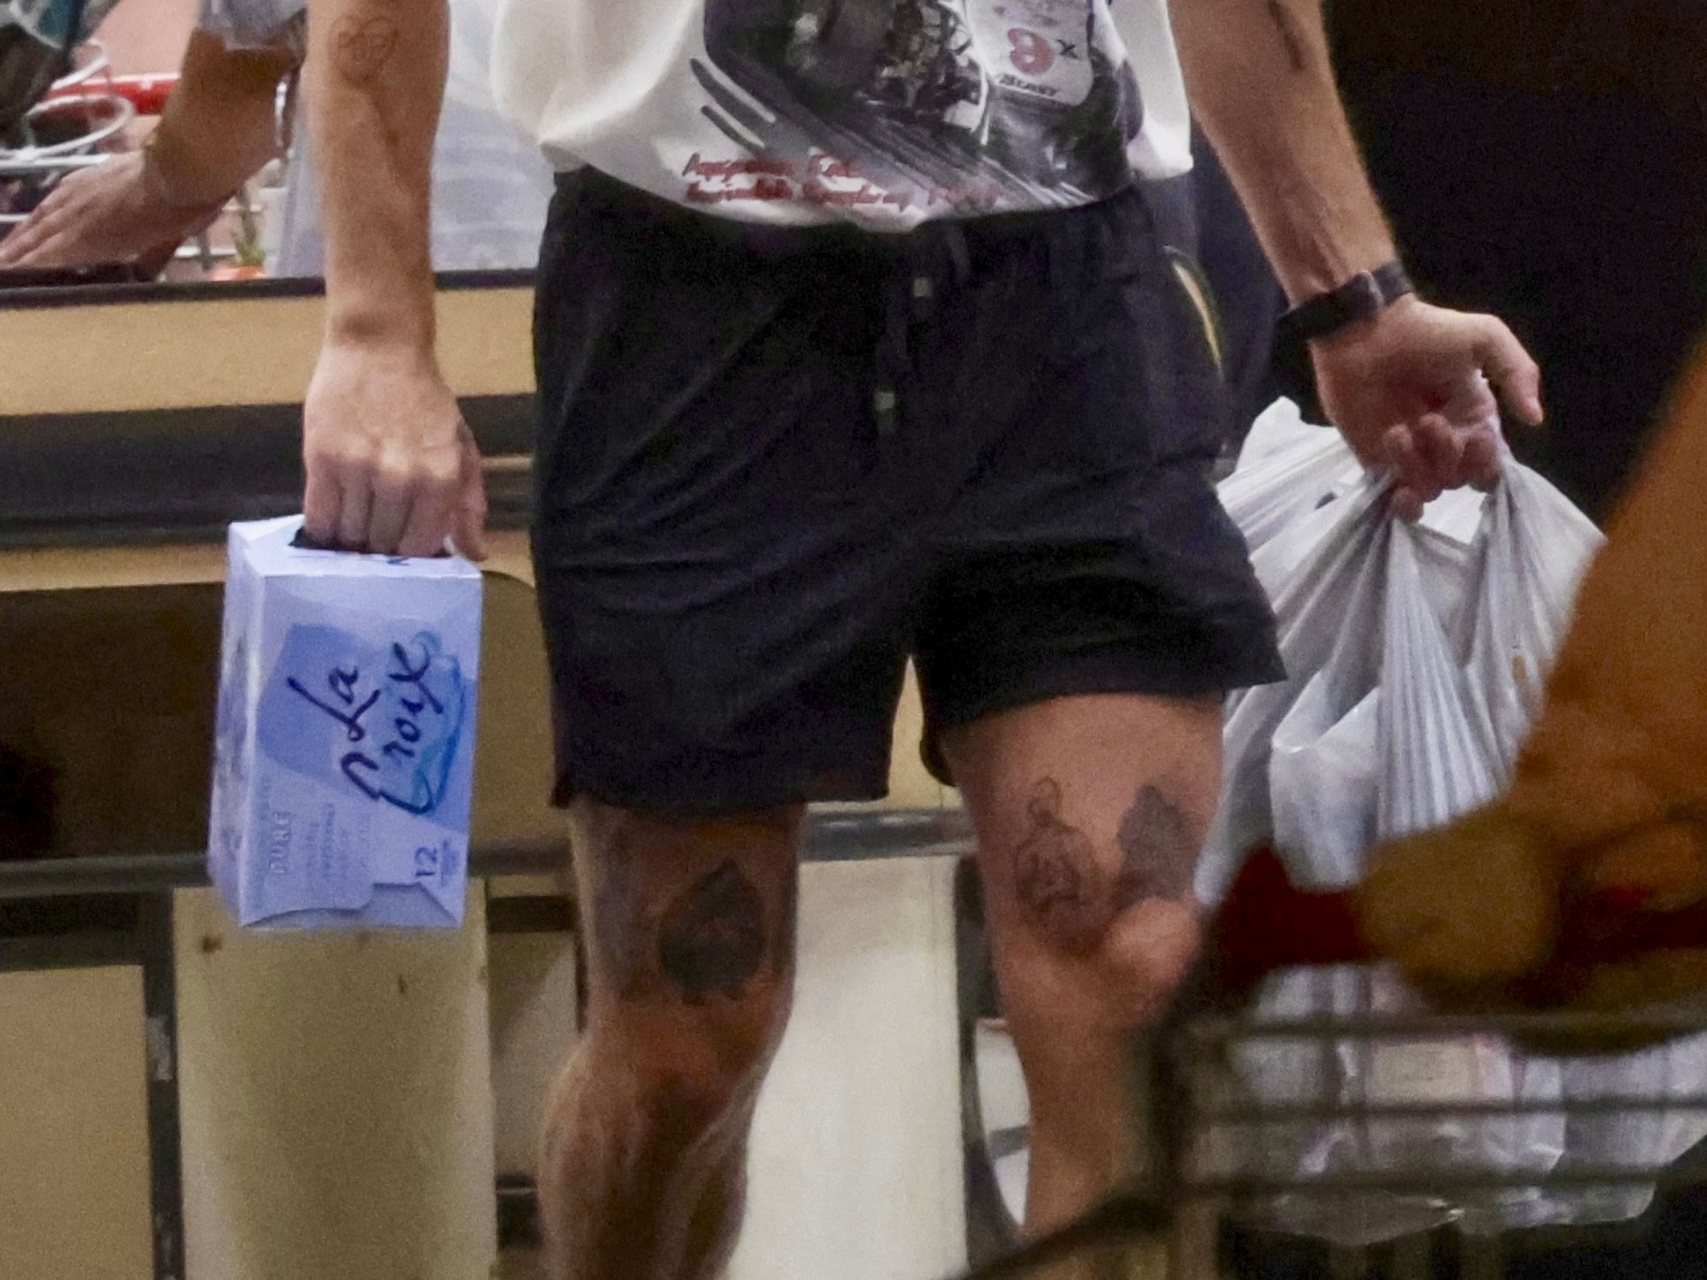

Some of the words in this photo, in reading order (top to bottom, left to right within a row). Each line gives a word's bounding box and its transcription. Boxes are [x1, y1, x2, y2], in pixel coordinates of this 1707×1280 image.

[286, 664, 382, 743] La
[340, 641, 445, 815] Croix
[414, 846, 438, 878] 12
